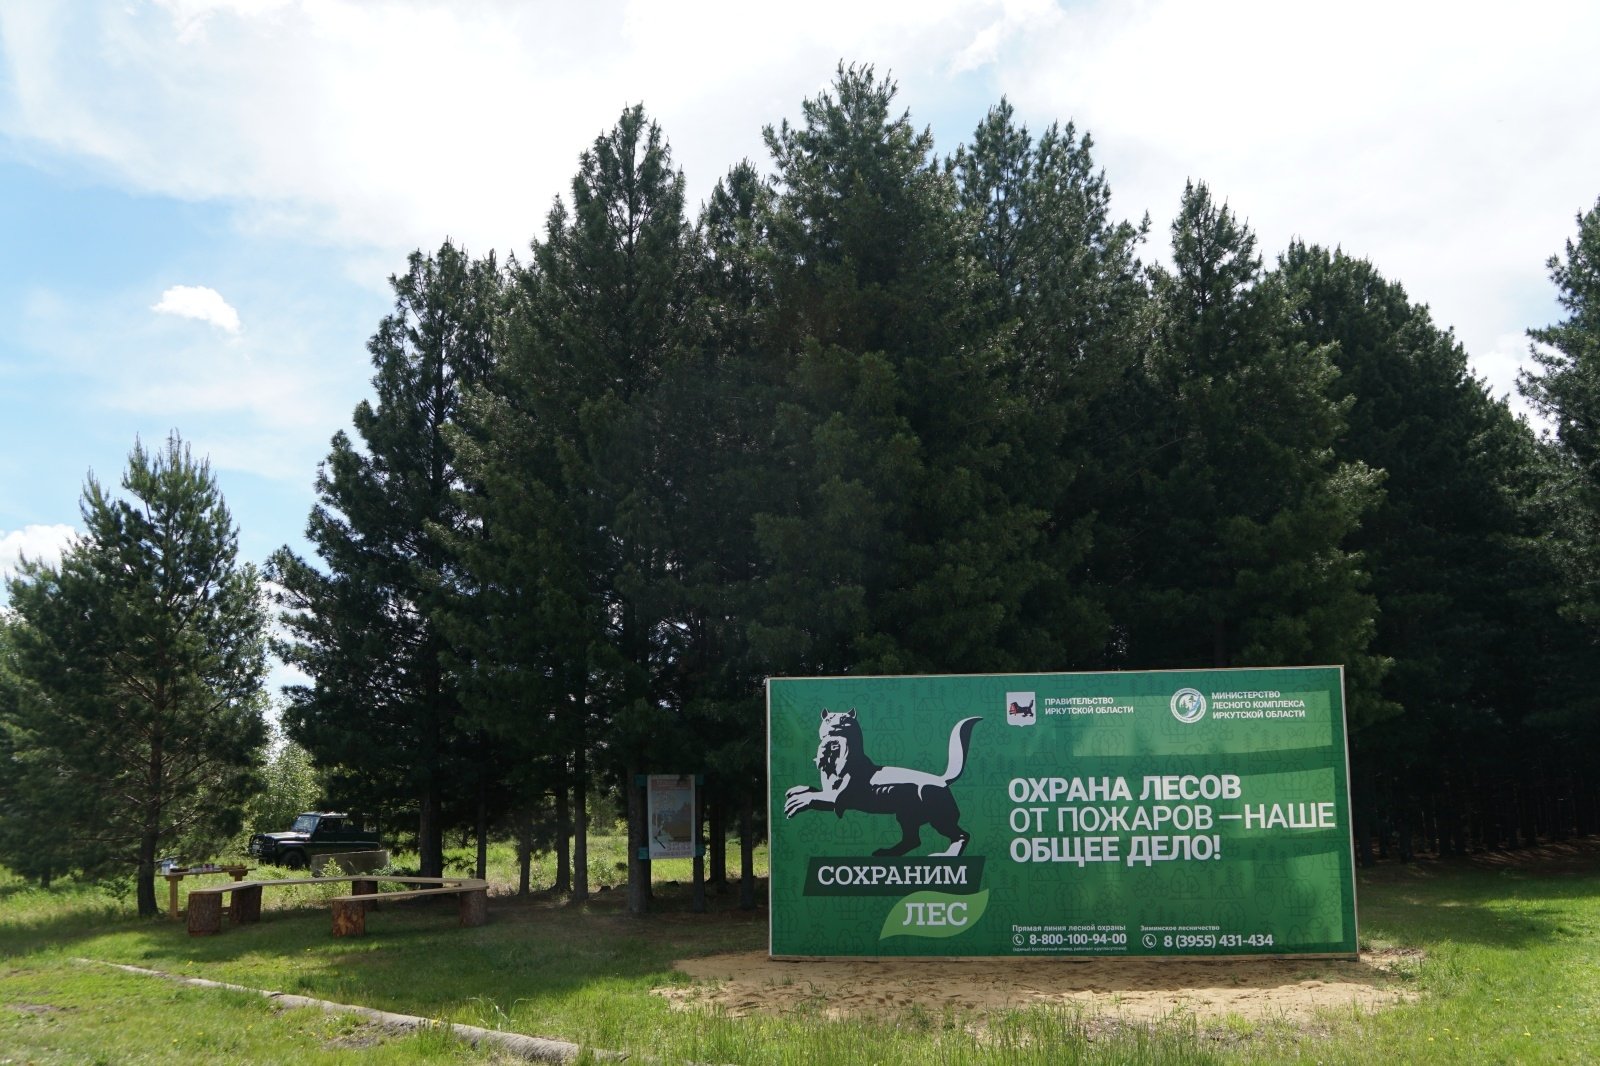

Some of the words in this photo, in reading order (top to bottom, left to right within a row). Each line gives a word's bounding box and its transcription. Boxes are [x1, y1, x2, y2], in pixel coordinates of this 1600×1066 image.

[1045, 697, 1114, 706] ПРАВИТЕЛЬСТВО
[1212, 691, 1281, 700] МИНИСТЕРСТВО
[1045, 706, 1094, 715] ИРКУТСКОЙ
[1095, 705, 1134, 714] ОБЛАСТИ
[1212, 701, 1251, 709] ЛЕСНОГО
[1253, 700, 1305, 709] КОМПЛЕКСА
[1212, 710, 1264, 719] ИРКУТСКОЙ
[1265, 710, 1306, 718] ОБЛАСТИ
[1008, 776, 1132, 802] ОХРАНА
[1139, 775, 1241, 801] ЛЕСОВ
[1009, 807, 1049, 832] ОТ
[1058, 805, 1213, 832] ПОЖАРОВ
[1010, 837, 1120, 867] ОБЩЕЕ
[1127, 835, 1221, 866] ДЕЛО!
[817, 865, 967, 885] СОХРАНИМ
[902, 902, 968, 926] ЛЕС
[1012, 925, 1041, 933] Прямая
[1029, 933, 1127, 945] 8-800-100-94-00
[1163, 935, 1173, 947] 8
[1175, 934, 1216, 949] (3955)
[1219, 934, 1274, 947] 431-434
